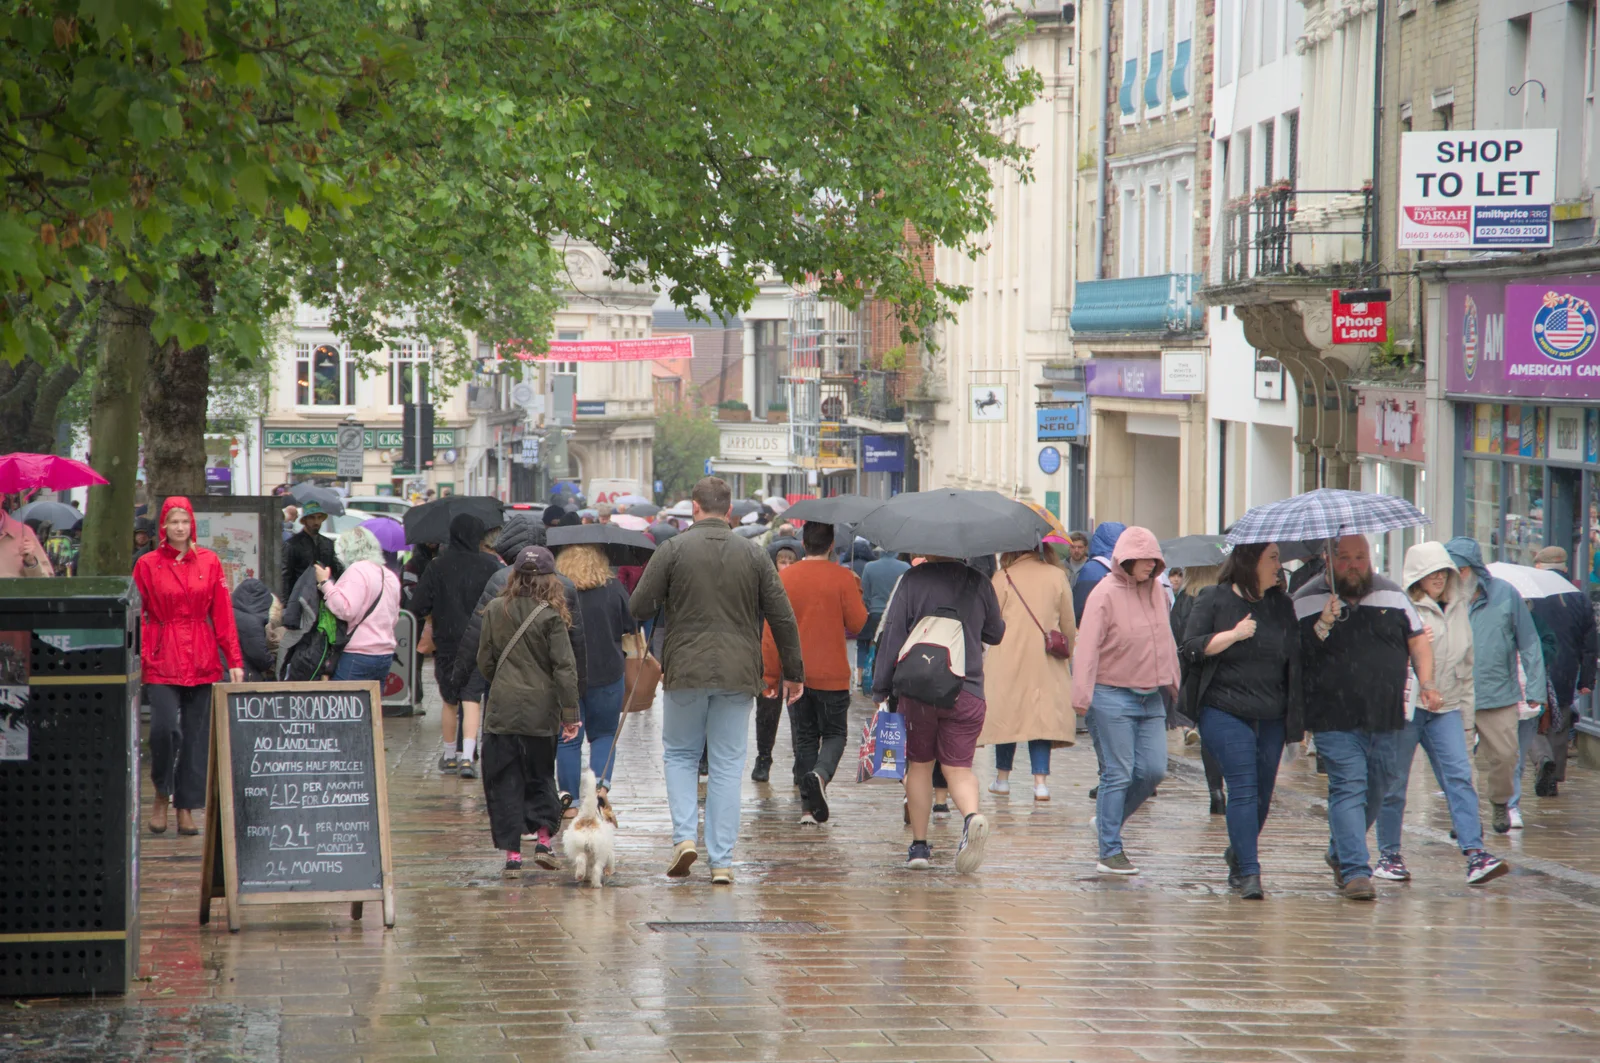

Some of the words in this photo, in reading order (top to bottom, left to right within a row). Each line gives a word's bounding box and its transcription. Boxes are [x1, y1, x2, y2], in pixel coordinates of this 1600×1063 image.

[1437, 140, 1523, 163] SHOP
[1416, 172, 1463, 197] TO
[1476, 171, 1540, 197] LET
[1414, 211, 1468, 220] DARRAH
[1477, 209, 1528, 220] smithprice
[1336, 316, 1383, 327] Phone
[1342, 326, 1377, 338] Land
[1509, 364, 1572, 376] AMERICAN
[268, 434, 306, 444] E-CIGS
[309, 434, 320, 444] &
[523, 440, 538, 449] WE
[236, 697, 285, 718] HOME
[290, 696, 364, 719] BROADBAND
[280, 723, 315, 734] WITH
[880, 730, 900, 740] M&S
[254, 737, 272, 750] NO
[277, 737, 338, 750] LANDLINE!
[251, 754, 260, 774] 6
[263, 762, 302, 772] MONTHS
[306, 761, 327, 771] HALF
[330, 761, 362, 771] PRICE!
[244, 788, 268, 796] FROM
[270, 784, 300, 806] £12
[303, 782, 322, 792] PER
[326, 782, 364, 790] MONTH
[302, 795, 318, 806] FOR
[322, 790, 328, 804] 6
[332, 793, 369, 804] MONTHS
[247, 826, 270, 837] FROM
[269, 824, 310, 848] £24
[316, 822, 334, 832] PER
[335, 822, 370, 832] MONTH
[333, 834, 358, 842] FROM
[317, 843, 353, 852] MONTH
[356, 842, 364, 852] 7
[266, 860, 287, 876] 24
[291, 861, 342, 875] MONTHS
